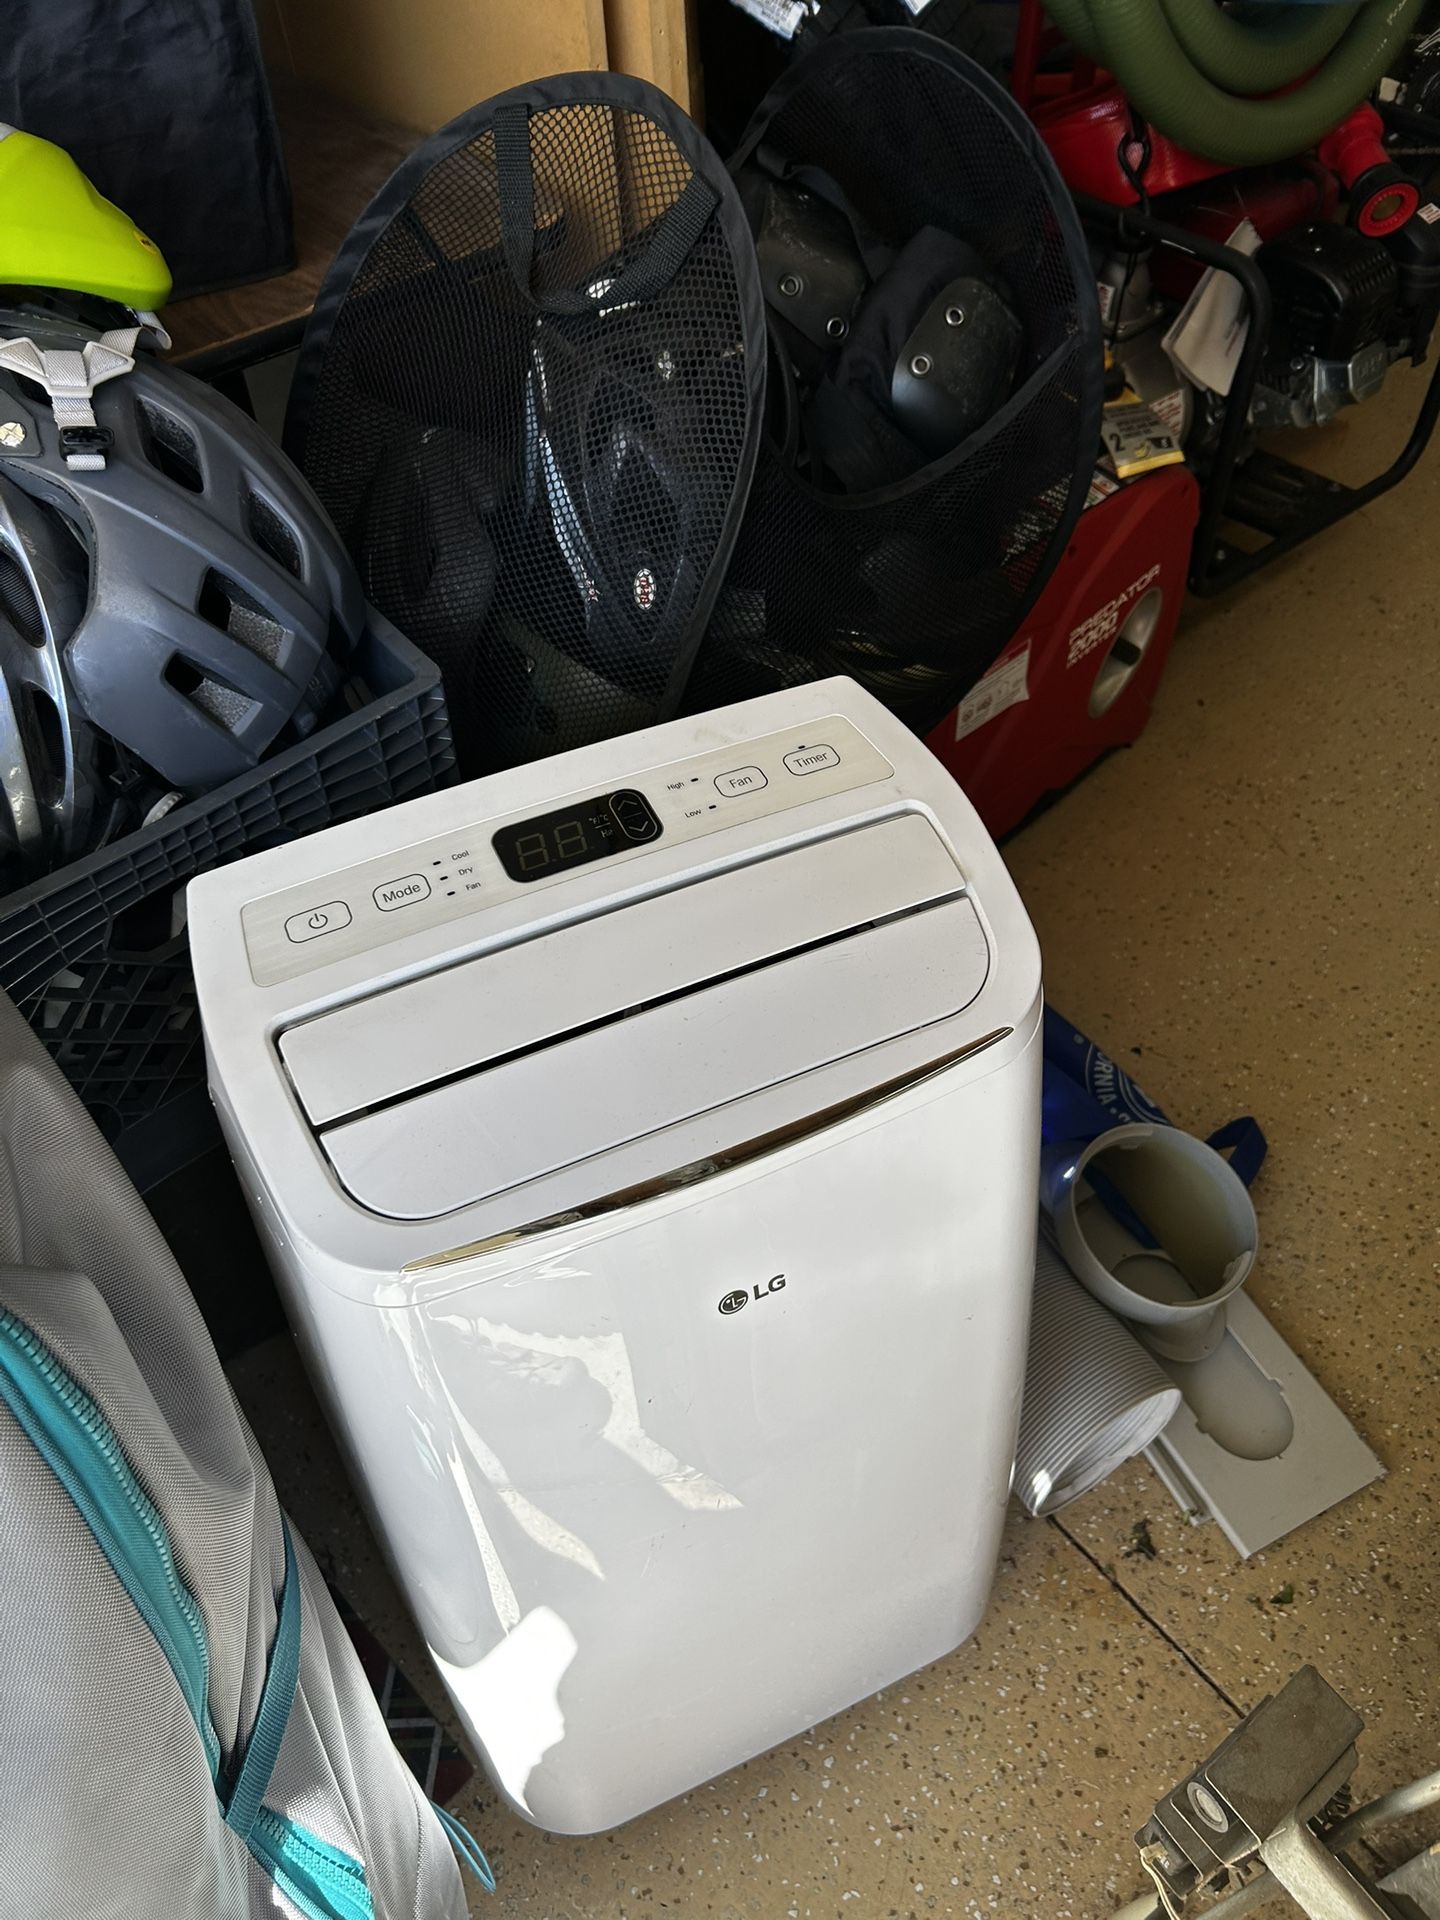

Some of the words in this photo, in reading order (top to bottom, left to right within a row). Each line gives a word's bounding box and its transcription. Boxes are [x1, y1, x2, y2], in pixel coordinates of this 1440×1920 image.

[1068, 563, 1161, 647] PREDATOR
[793, 752, 828, 769] Timer
[666, 781, 685, 791] High
[728, 776, 753, 789] Fan
[685, 808, 702, 818] Low
[451, 850, 470, 861] Cool
[458, 866, 473, 876] Dry
[465, 880, 481, 891] Fan
[382, 882, 421, 903] Mode
[752, 1273, 787, 1301] LG
